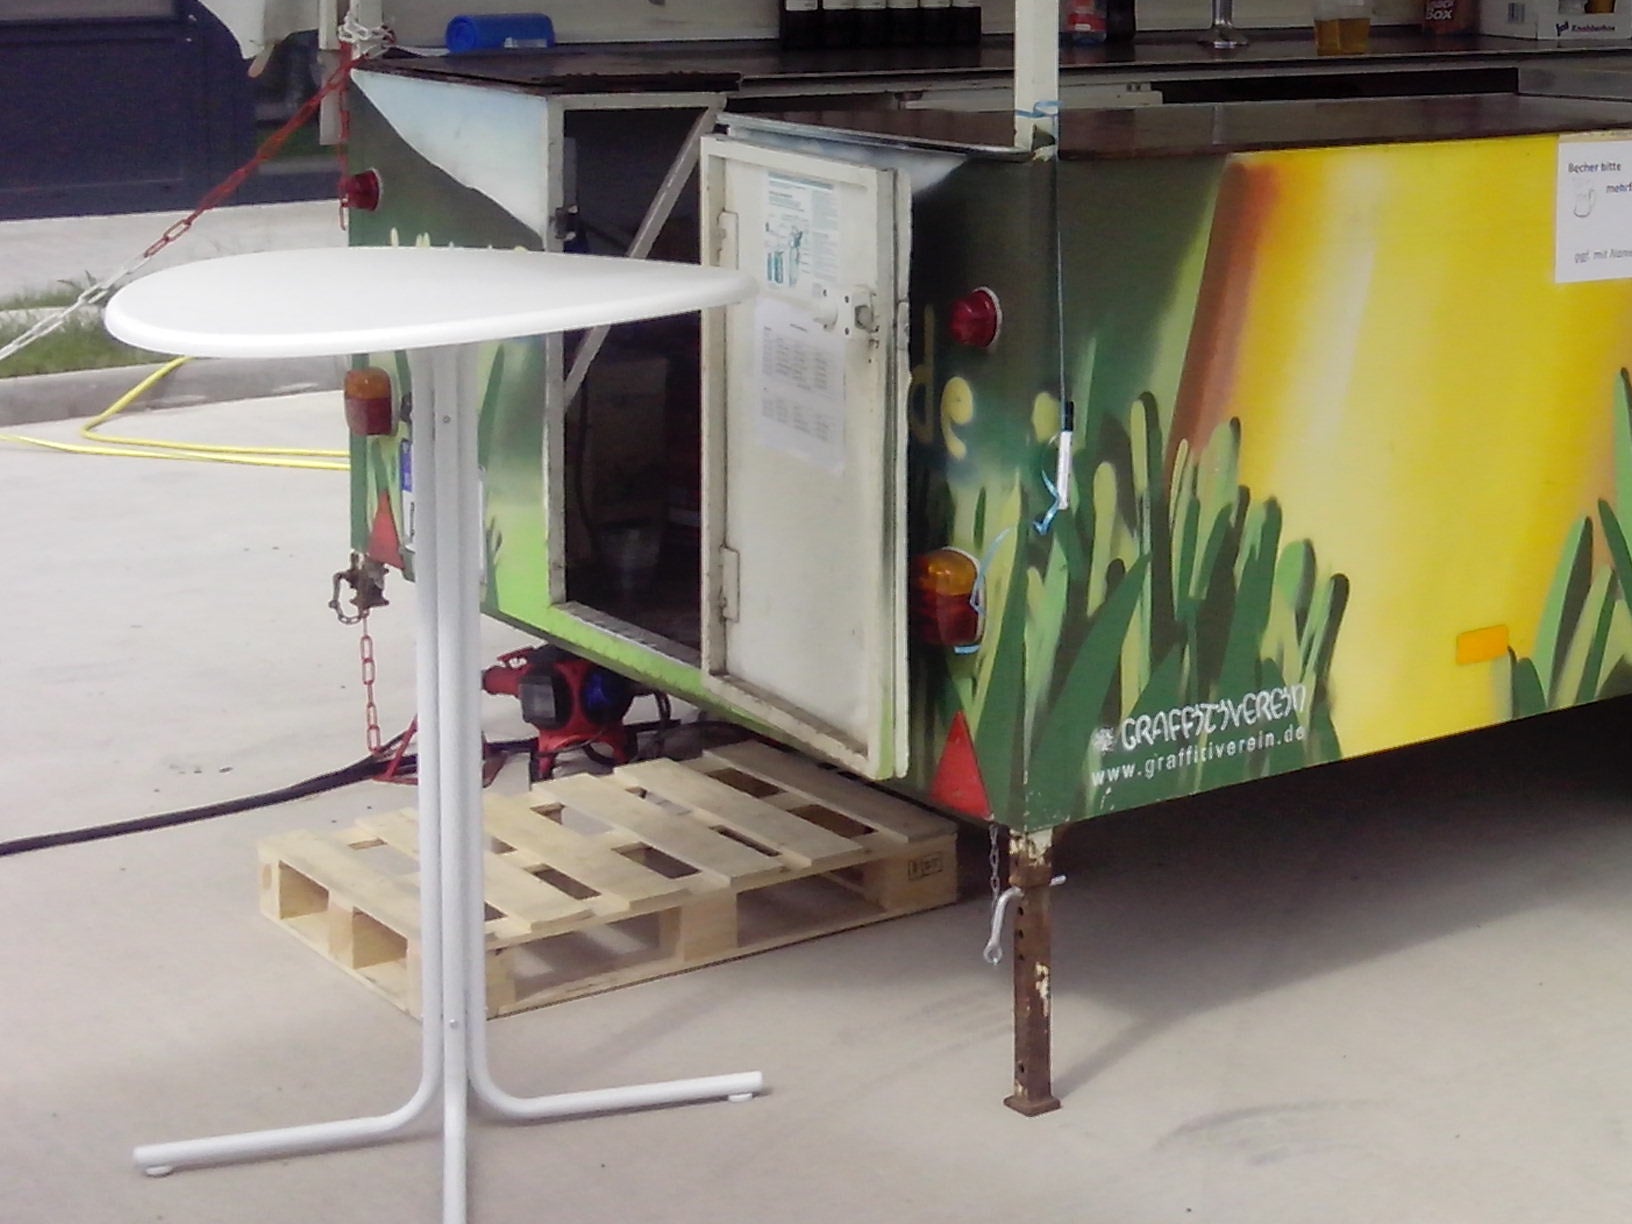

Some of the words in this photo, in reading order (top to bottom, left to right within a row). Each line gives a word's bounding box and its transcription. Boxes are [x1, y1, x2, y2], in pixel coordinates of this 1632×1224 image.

[1567, 162, 1599, 173] Becher
[1600, 161, 1622, 172] bitte
[1090, 722, 1308, 787] www.graffitiverein.de
